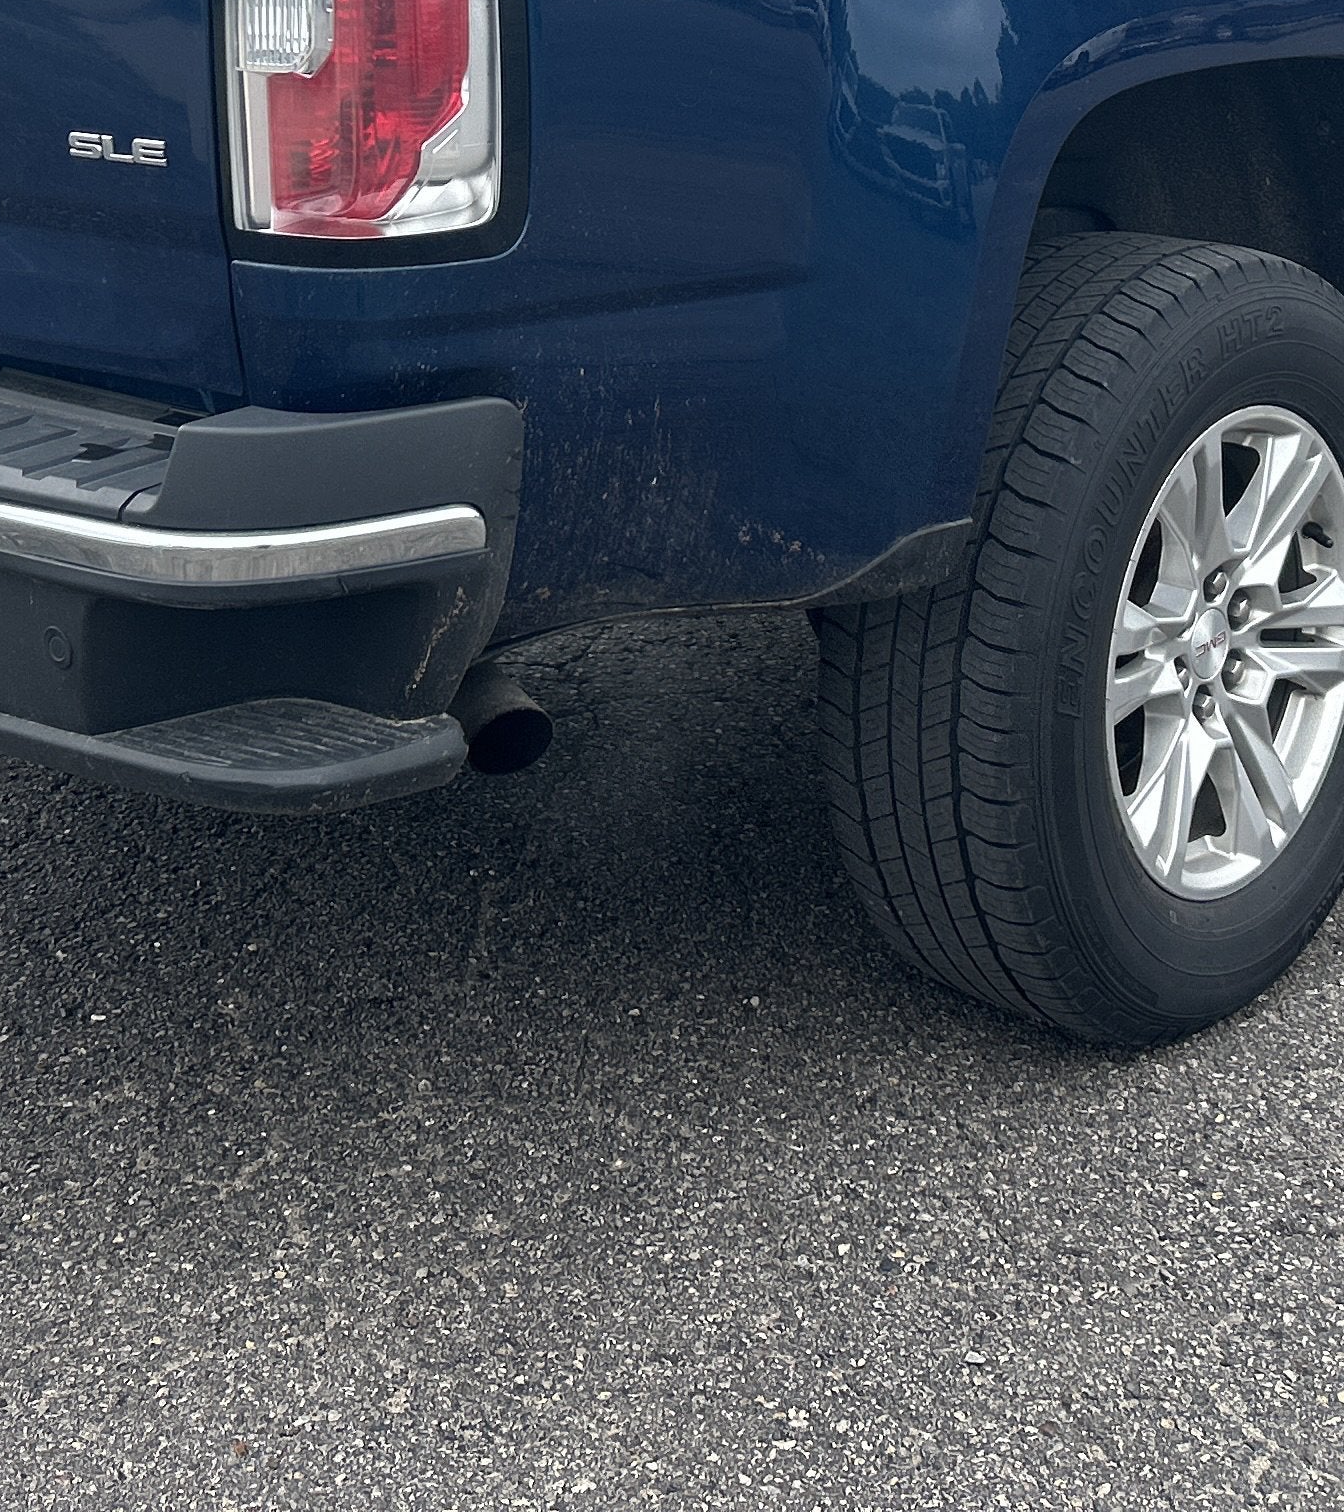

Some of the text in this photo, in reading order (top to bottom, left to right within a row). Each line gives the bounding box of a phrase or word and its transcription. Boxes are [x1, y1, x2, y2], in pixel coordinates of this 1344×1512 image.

[68, 130, 168, 167] SLE
[1059, 305, 1285, 719] ENCOUNTER HT2
[1195, 631, 1226, 657] GMC
